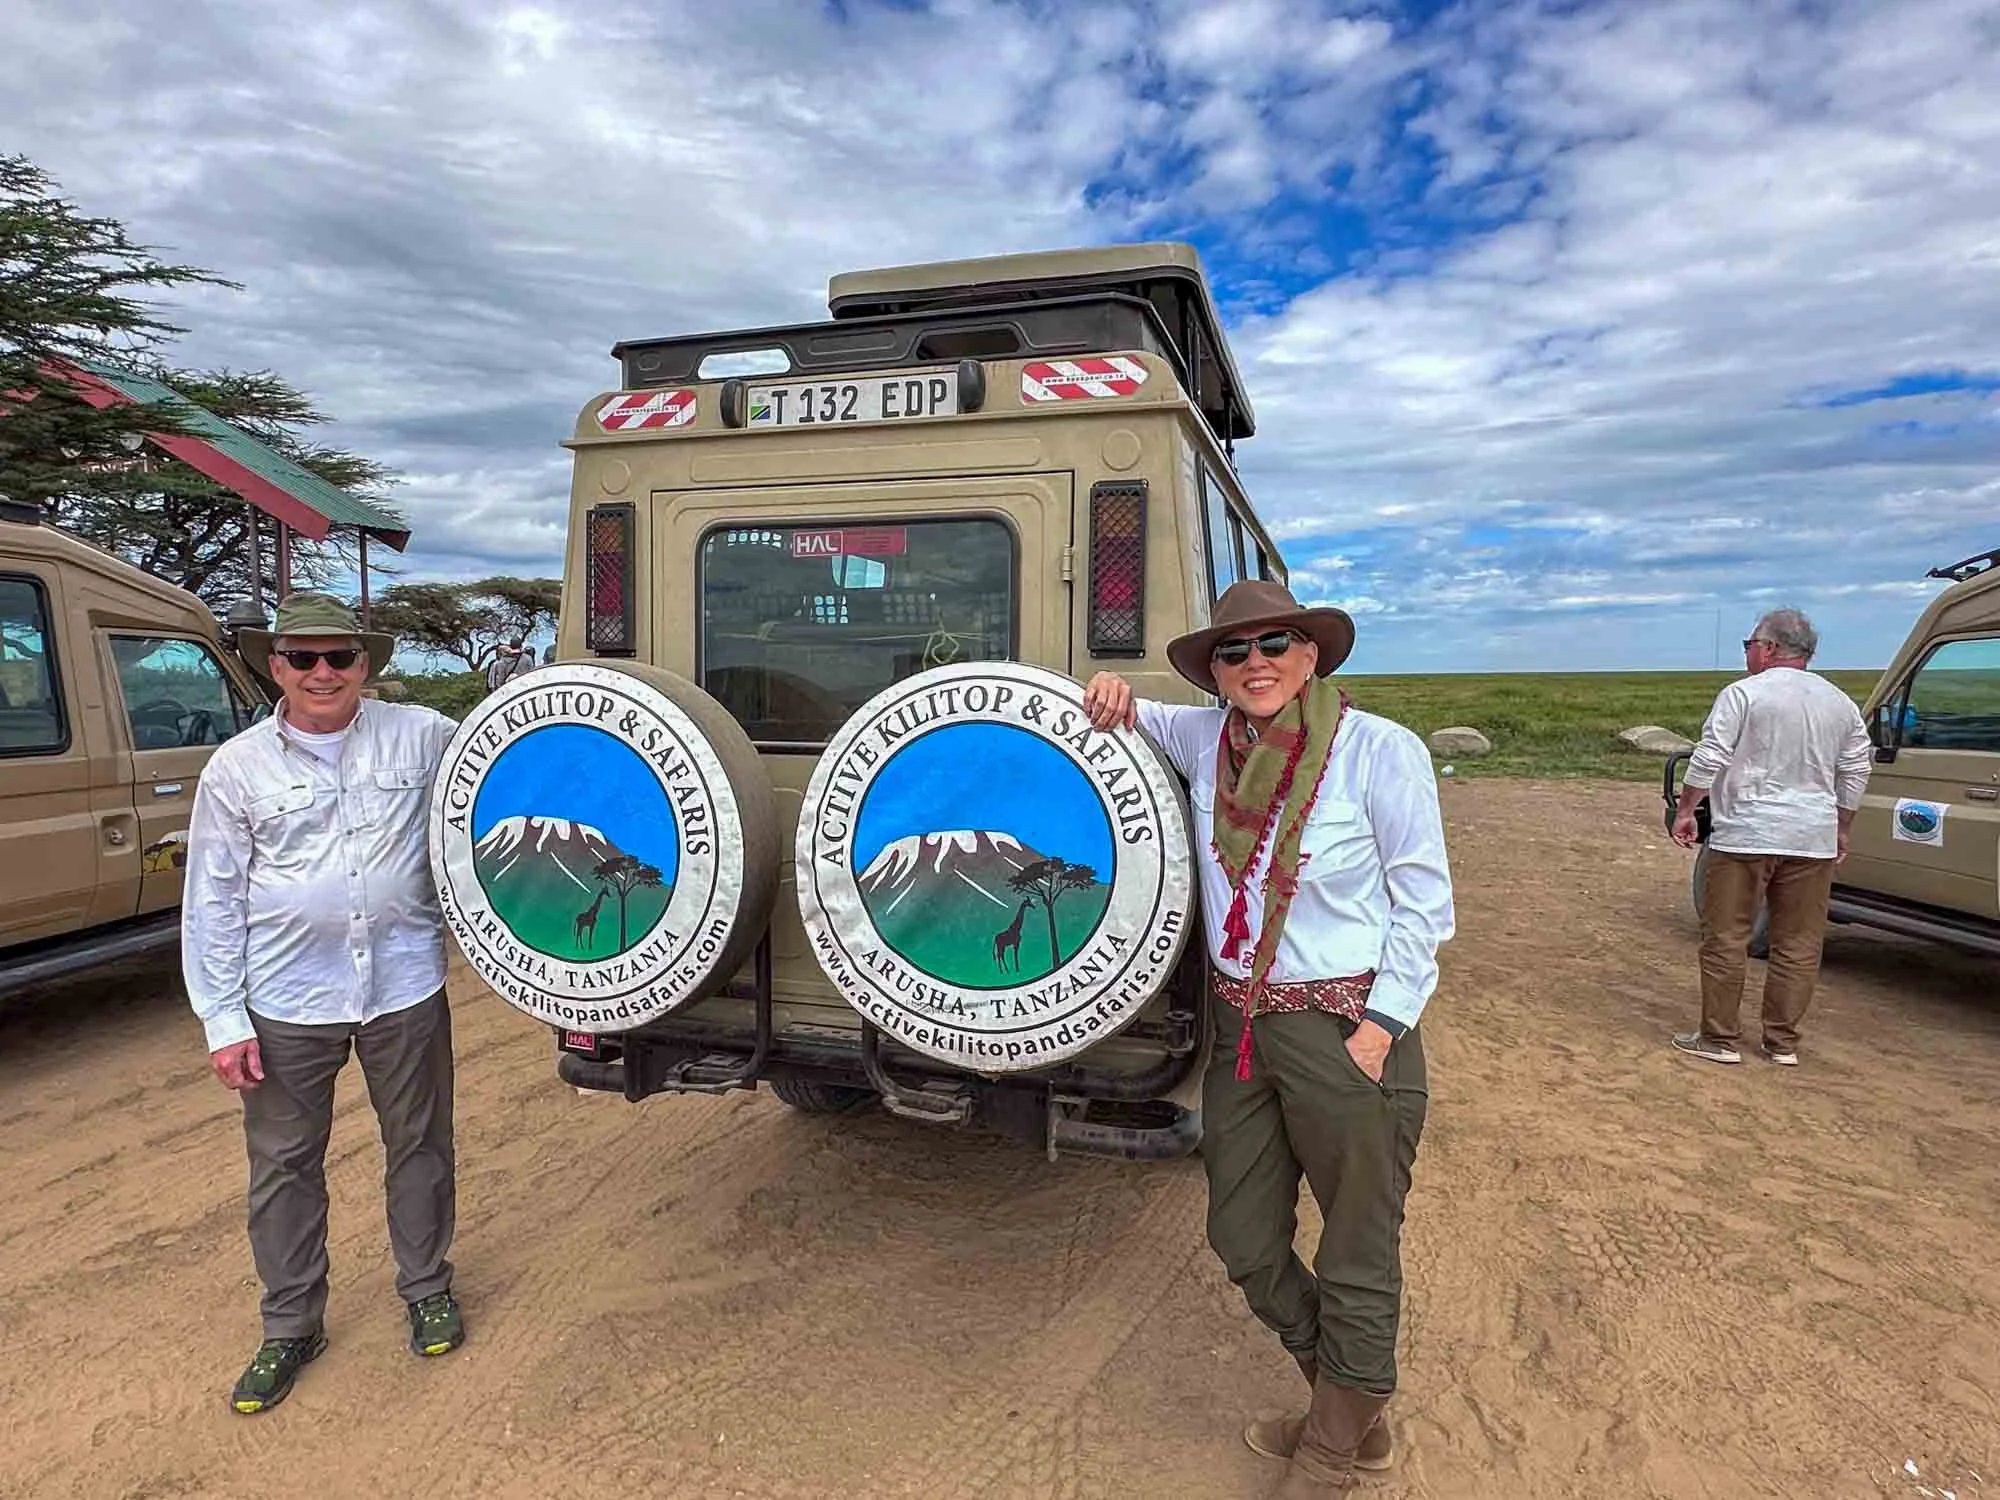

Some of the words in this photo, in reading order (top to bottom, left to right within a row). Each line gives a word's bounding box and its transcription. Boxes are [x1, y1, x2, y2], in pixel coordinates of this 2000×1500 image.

[772, 390, 788, 424] T
[799, 385, 858, 423] 132
[881, 379, 947, 418] EDP
[797, 535, 839, 553] HAL
[447, 726, 503, 834] ACTIVE
[502, 690, 615, 733] KILITOP
[619, 709, 639, 738] &
[641, 729, 711, 856] SAFARIS
[821, 742, 878, 868] ACTIVE
[878, 685, 1014, 748] KILITOP
[1021, 694, 1047, 725] &
[1052, 709, 1152, 845] SAFARIS
[440, 885, 729, 1025] www.activekilitopandsafaris.com
[471, 909, 554, 987] ARUSHA,
[564, 929, 680, 989] TANZANIA
[816, 909, 1183, 1061] www.activekilitopandsafaris.com
[861, 947, 977, 1021] ARUSHA,
[990, 932, 1128, 1020] TANZANIA
[569, 1033, 592, 1046] HAL
